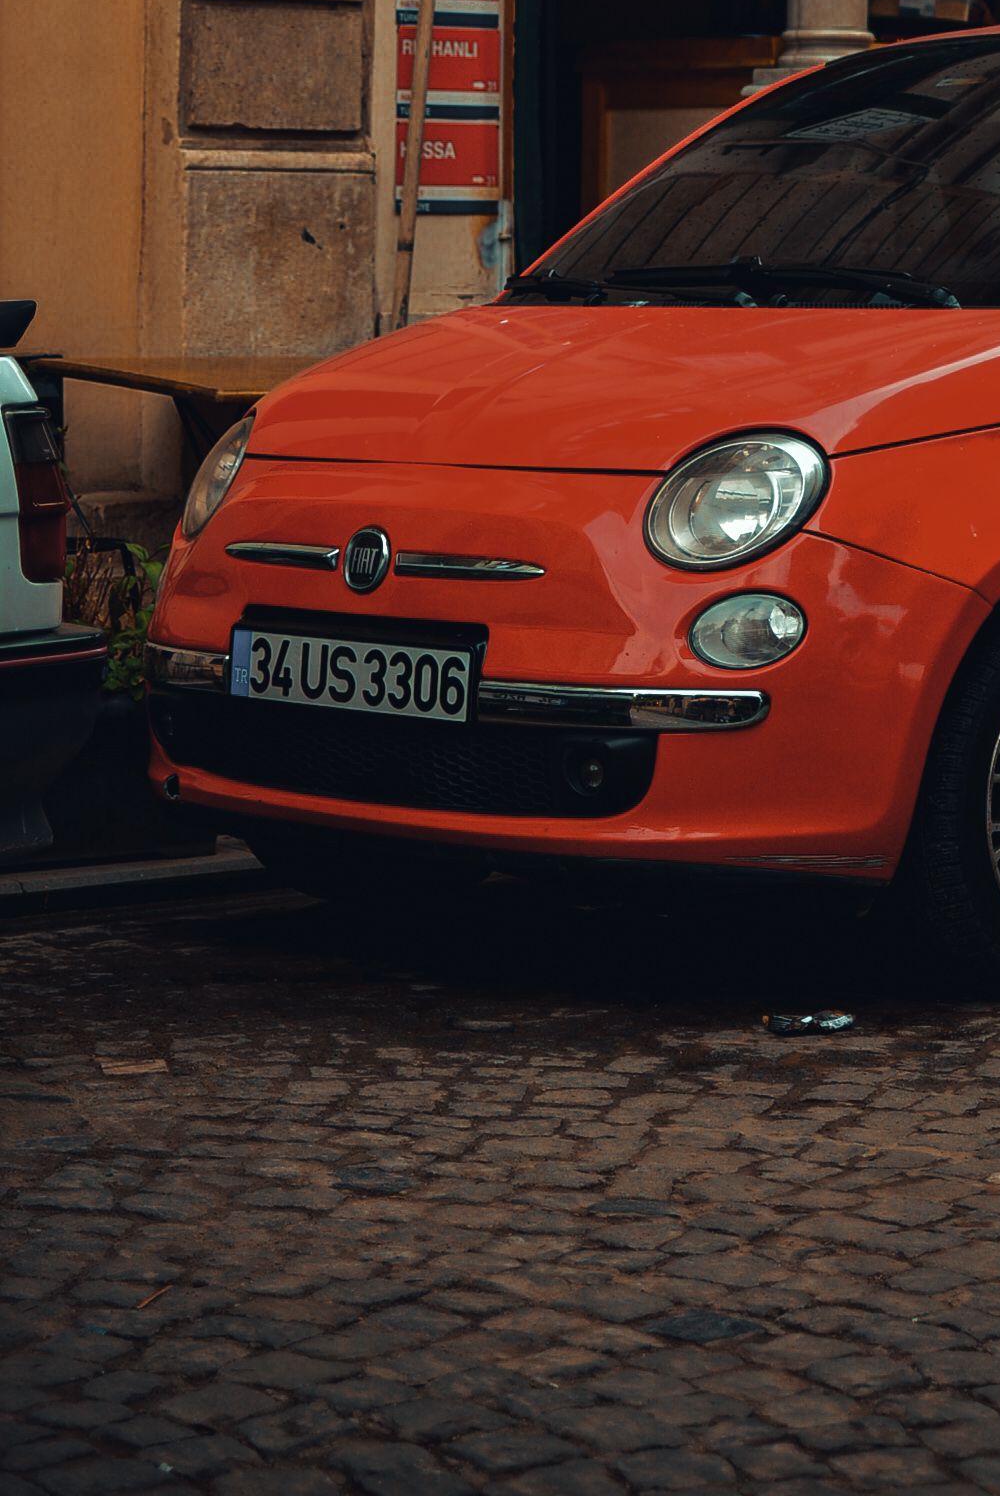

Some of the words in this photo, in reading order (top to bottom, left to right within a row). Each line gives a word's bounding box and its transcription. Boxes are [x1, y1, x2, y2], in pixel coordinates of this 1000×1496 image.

[402, 39, 478, 57] RHANLI
[400, 141, 456, 159] HSSA
[351, 547, 378, 575] FIAT
[234, 667, 248, 684] TR
[250, 637, 293, 697] 34
[300, 642, 358, 703] US
[362, 649, 466, 715] 3306
